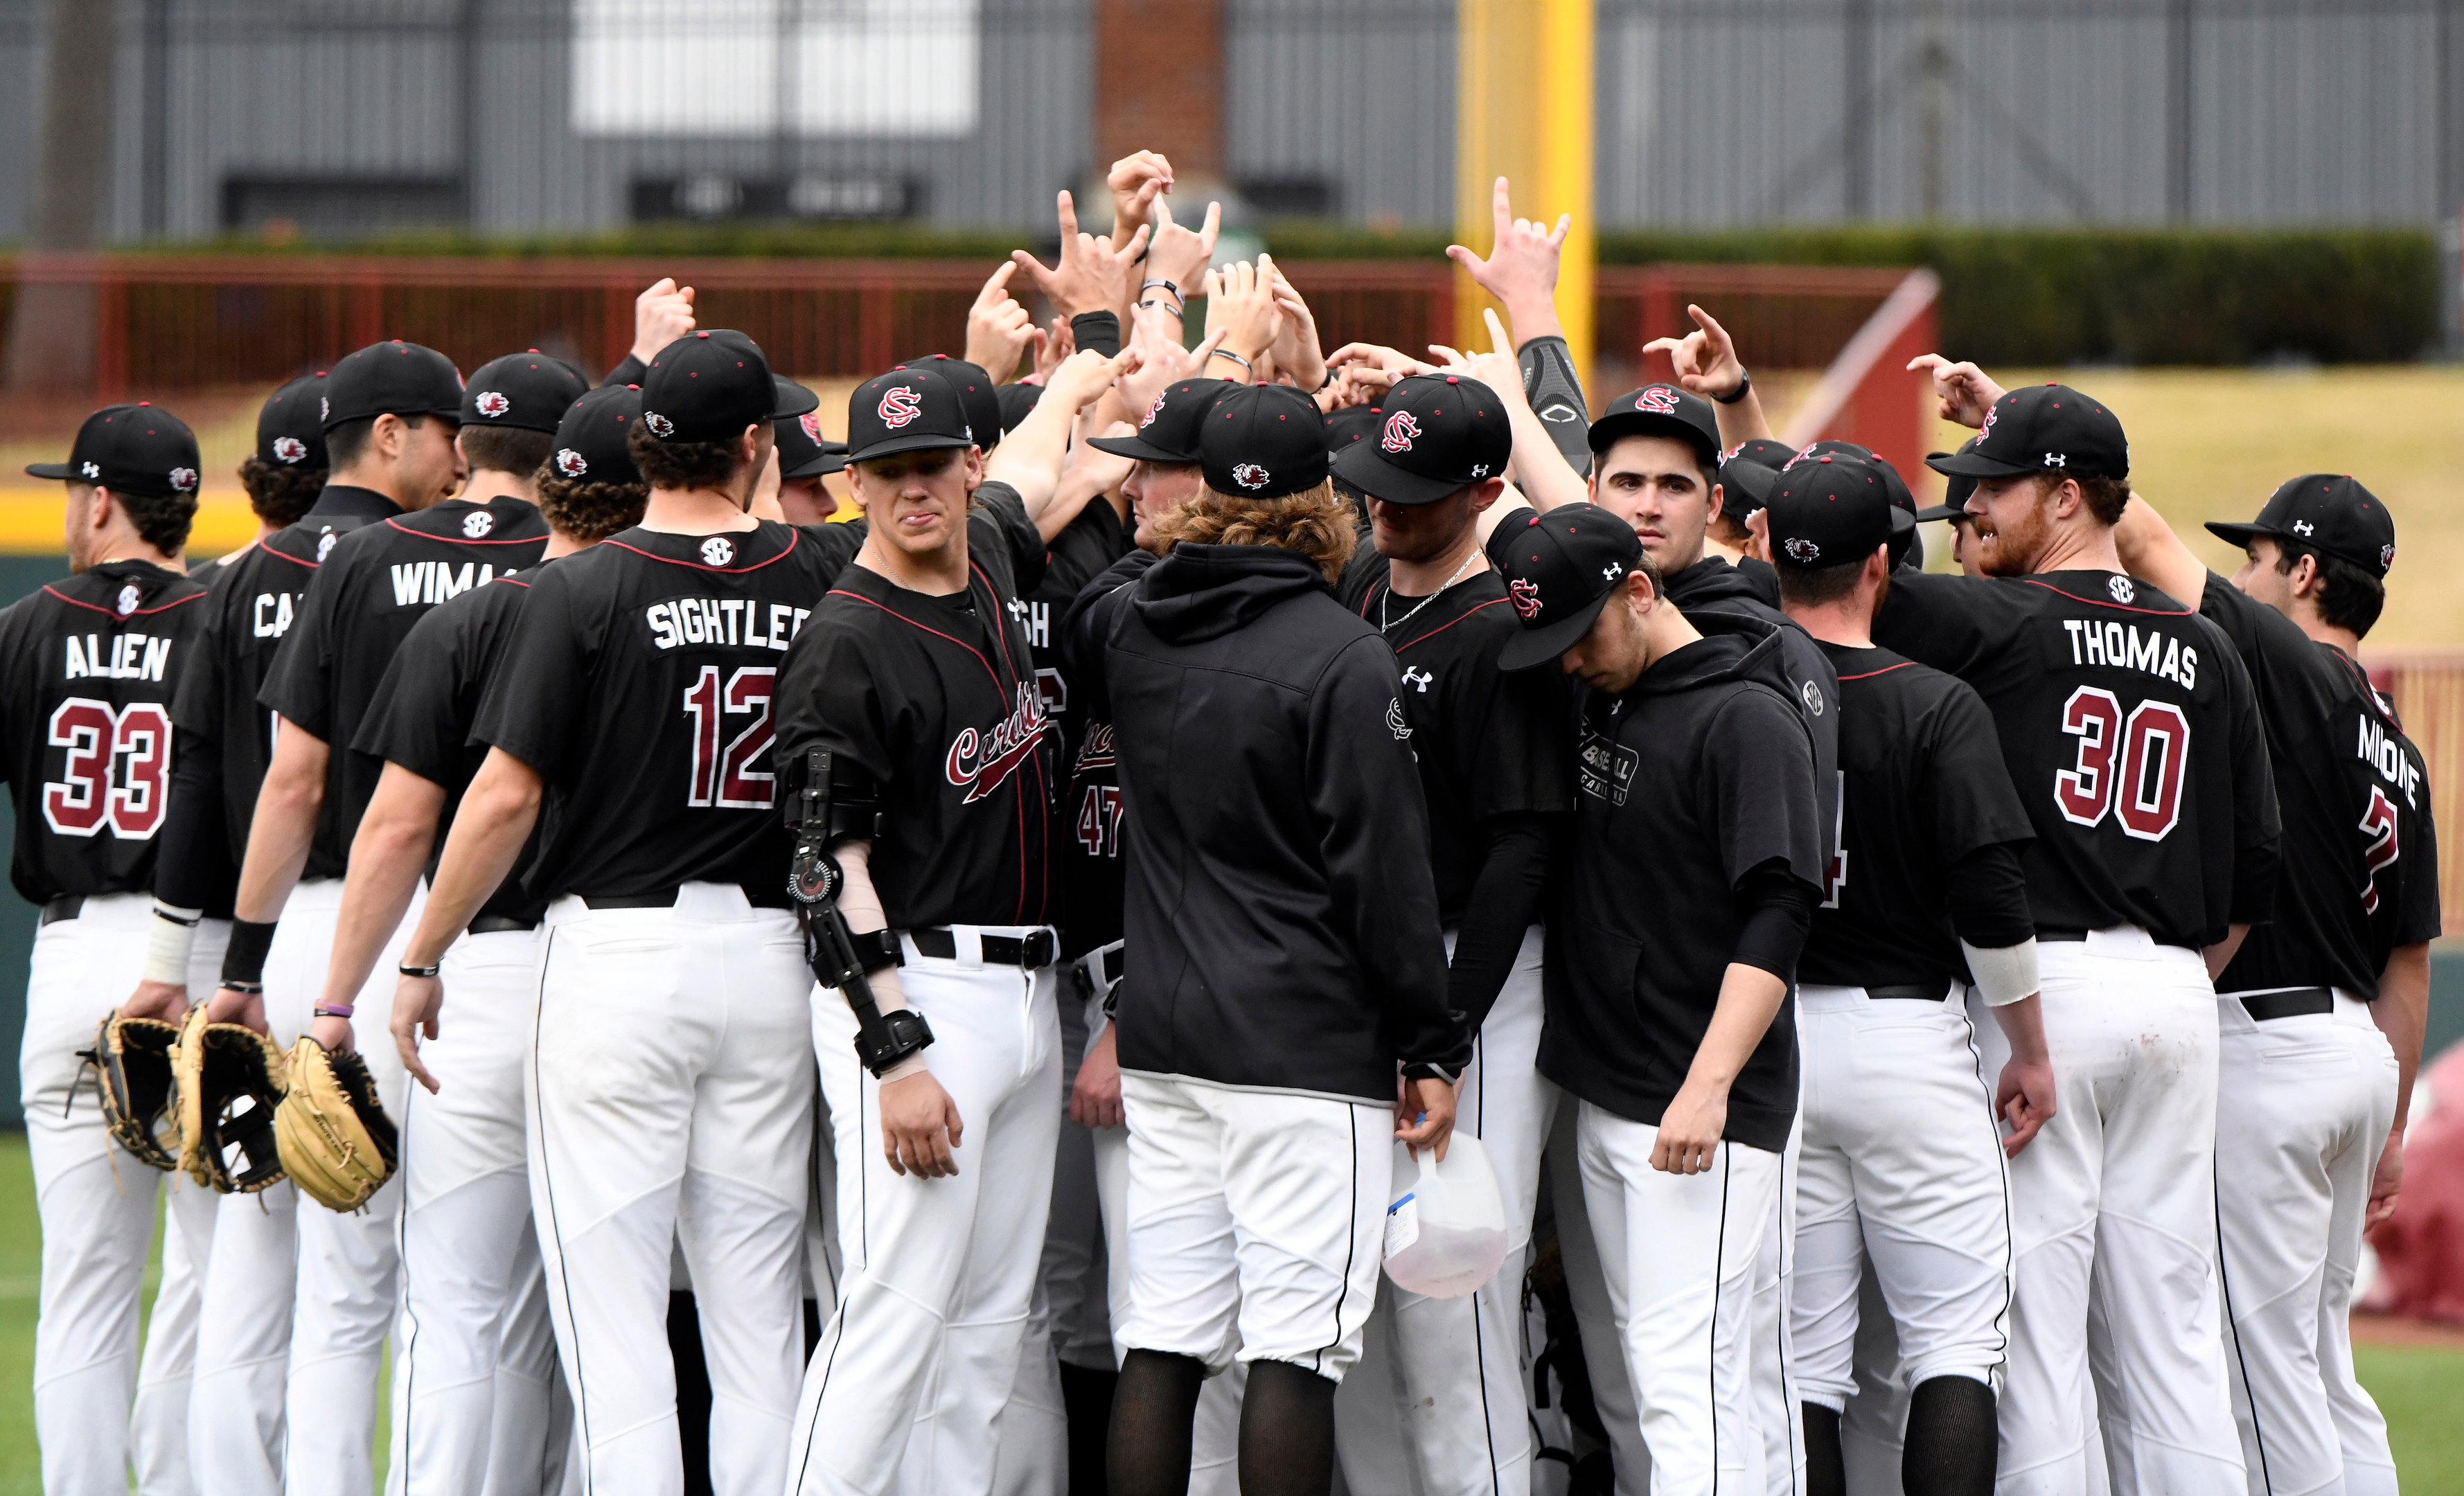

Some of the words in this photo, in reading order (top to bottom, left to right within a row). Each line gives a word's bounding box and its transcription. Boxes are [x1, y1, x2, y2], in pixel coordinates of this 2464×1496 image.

[462, 510, 494, 538] SEC
[700, 537, 734, 567] SEC
[2108, 575, 2135, 603] SEC
[2063, 619, 2198, 691] THOMAS
[42, 697, 172, 841] 33
[683, 665, 777, 810] 12
[2054, 684, 2190, 842] 30
[1076, 785, 1124, 857] 47
